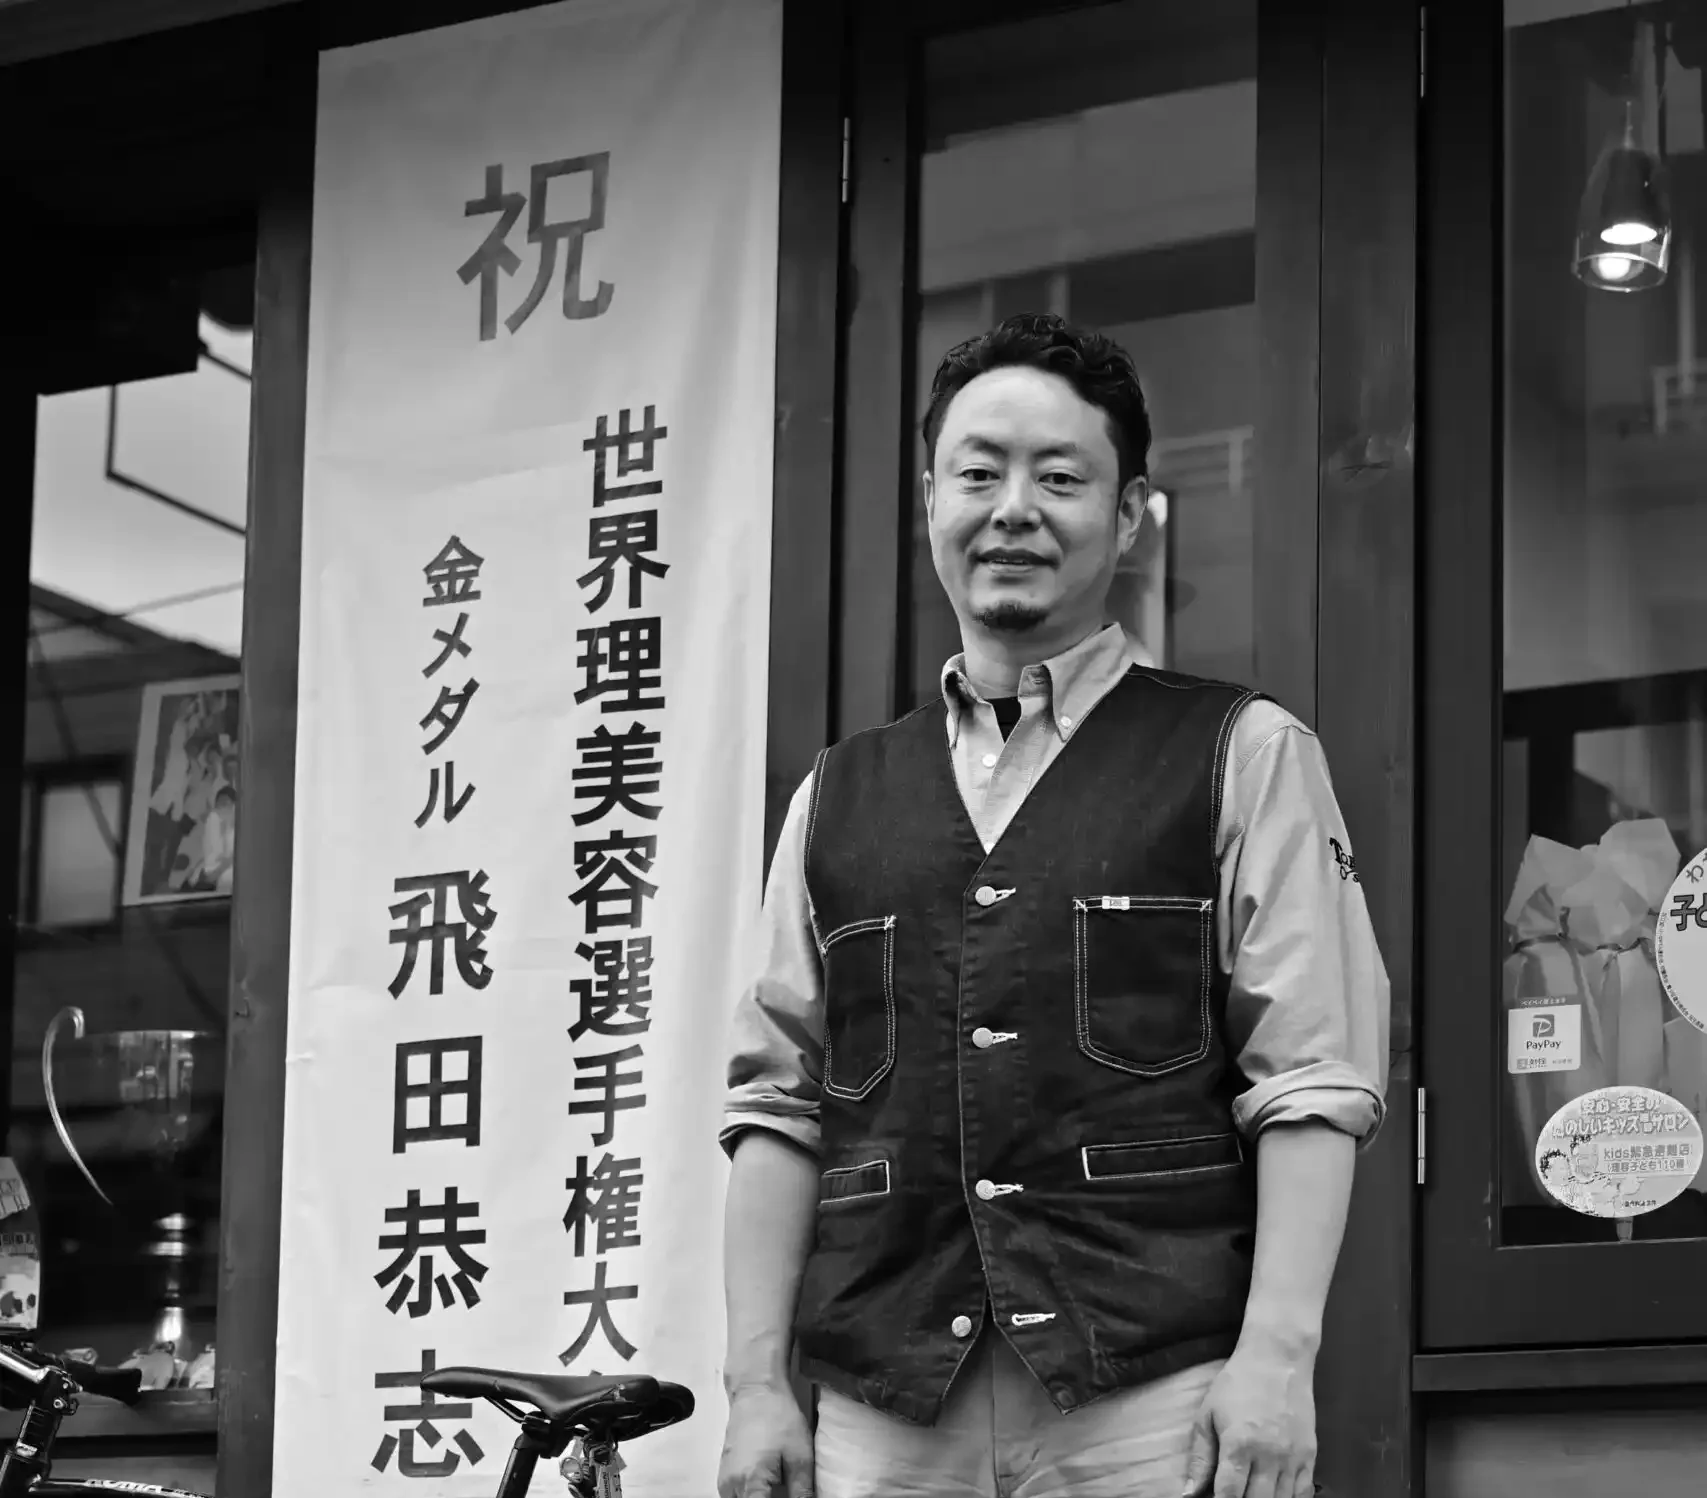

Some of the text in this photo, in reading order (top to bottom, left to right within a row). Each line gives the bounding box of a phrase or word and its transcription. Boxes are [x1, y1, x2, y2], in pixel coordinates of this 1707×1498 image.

[456, 151, 615, 341] 祝
[559, 405, 670, 1376] 世界理美容選手権大
[1526, 1039, 1562, 1051] PayPay
[371, 867, 498, 1479] 飛田恭志
